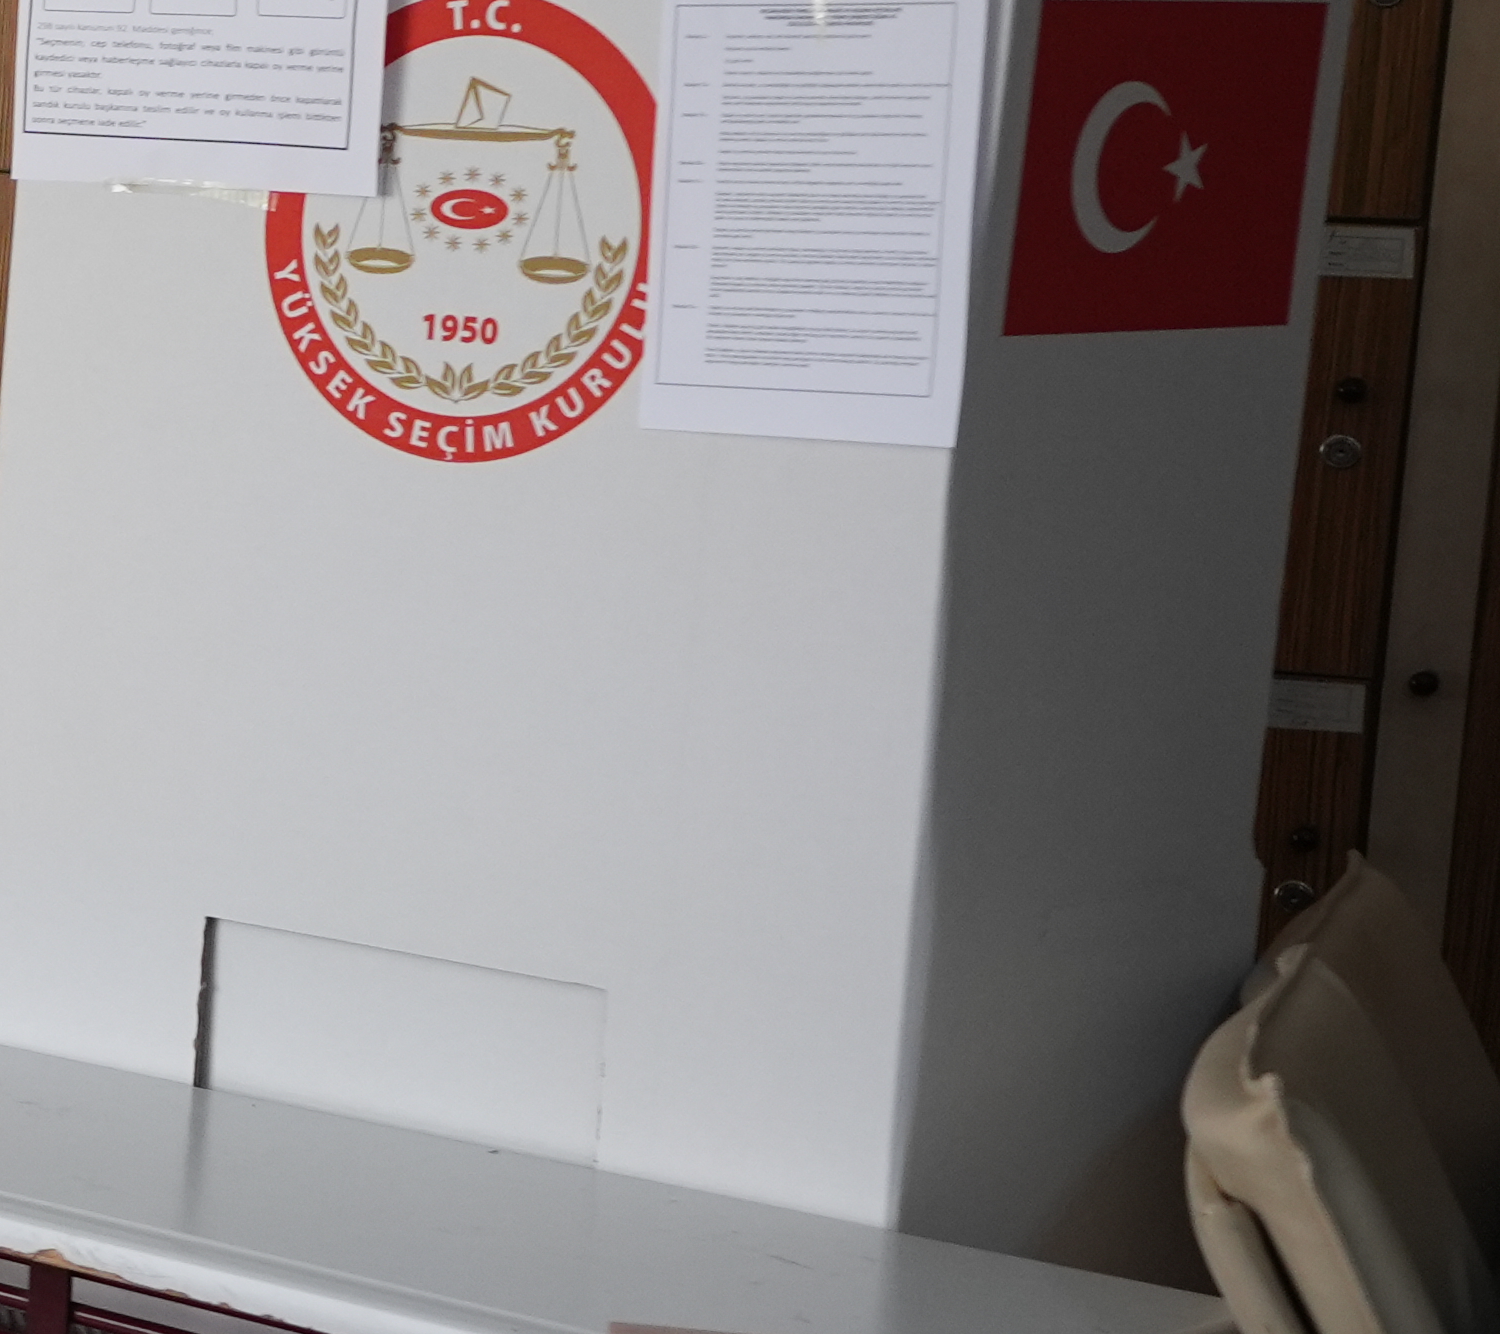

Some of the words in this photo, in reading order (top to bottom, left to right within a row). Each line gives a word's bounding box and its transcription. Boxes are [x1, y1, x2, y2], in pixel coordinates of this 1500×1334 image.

[445, 0, 522, 33] T.C.
[423, 313, 499, 345] 1950
[272, 259, 378, 421] YÜKSEK
[383, 410, 516, 461] SEÇİM
